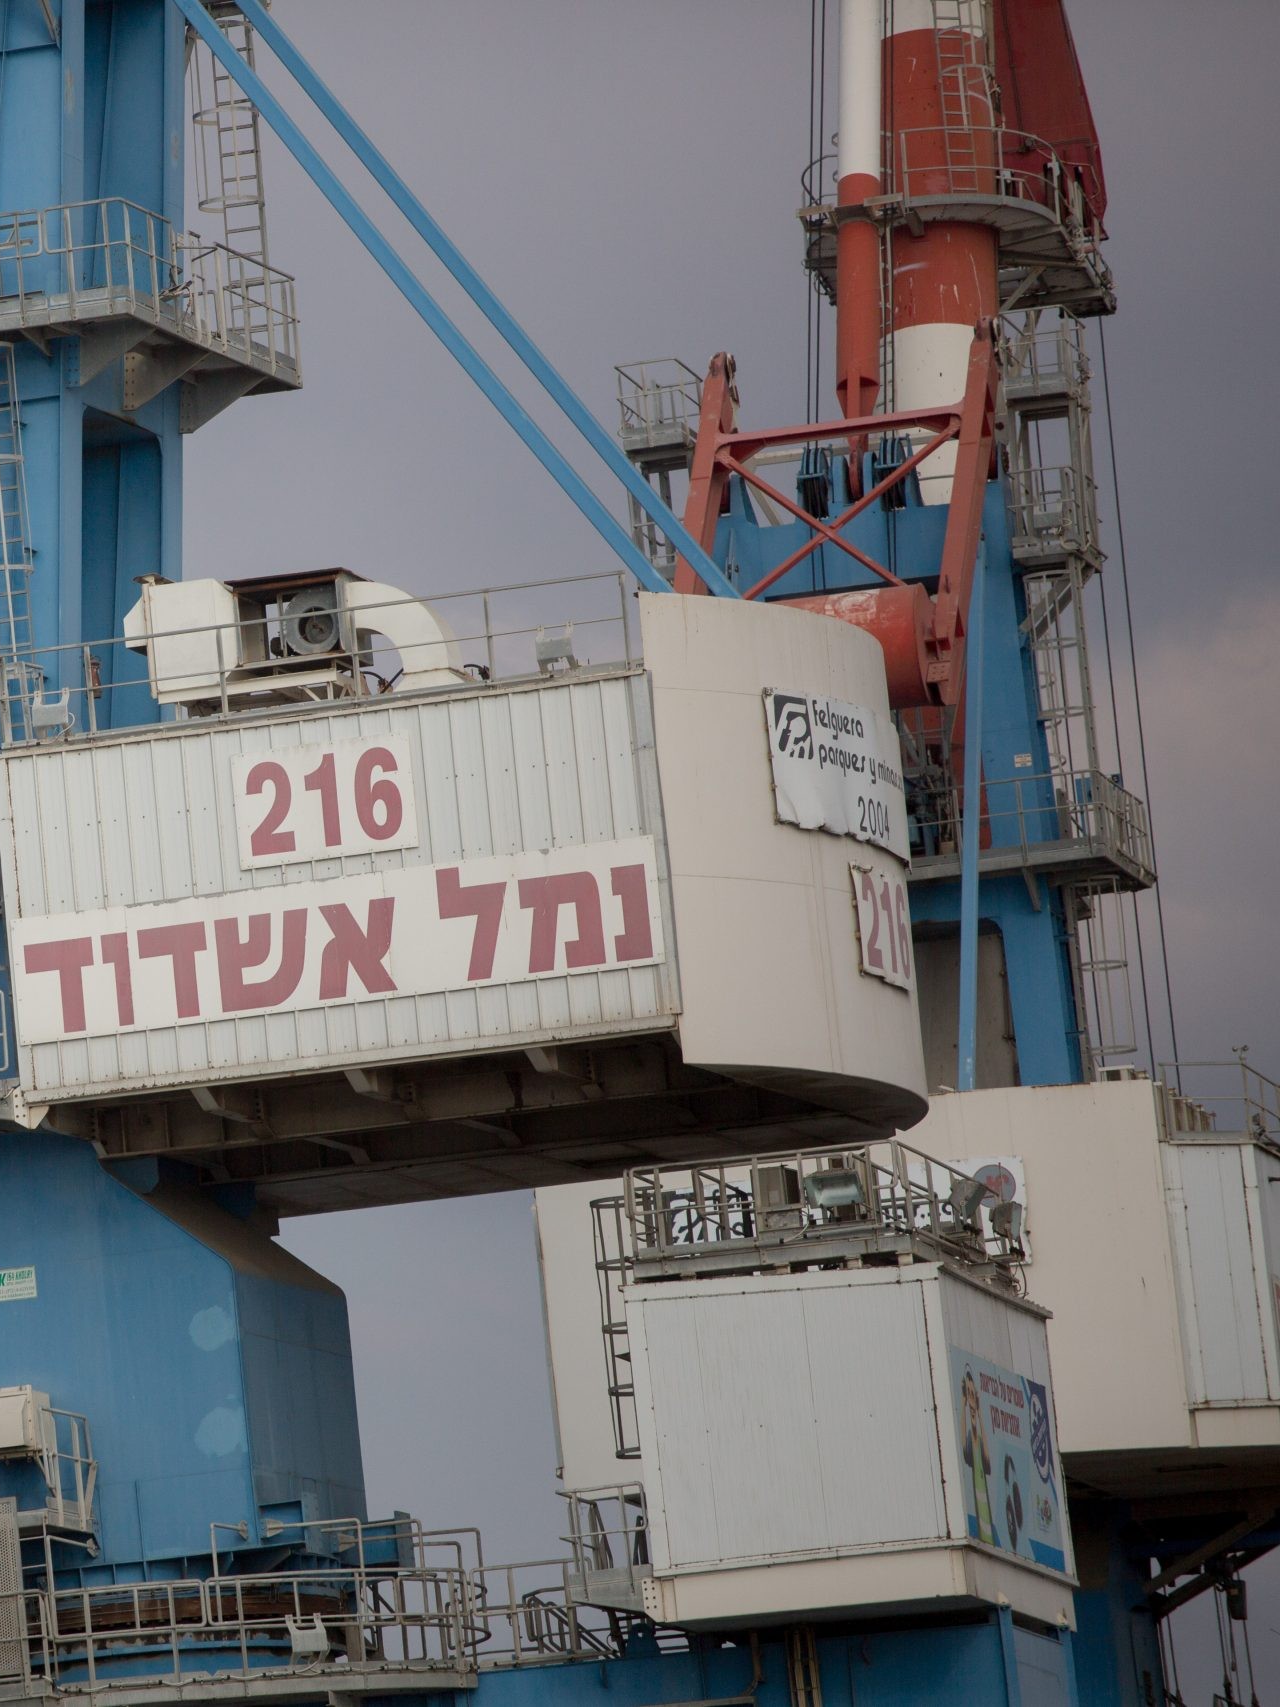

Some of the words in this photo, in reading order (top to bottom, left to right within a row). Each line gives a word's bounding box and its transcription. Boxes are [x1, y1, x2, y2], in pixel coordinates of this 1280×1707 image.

[245, 747, 403, 856] 216
[819, 744, 865, 777] parques
[869, 757, 876, 784] y
[858, 796, 889, 840] 2004
[24, 896, 398, 1034] אשדוד
[435, 863, 654, 982] נמל
[862, 872, 910, 979] 216
